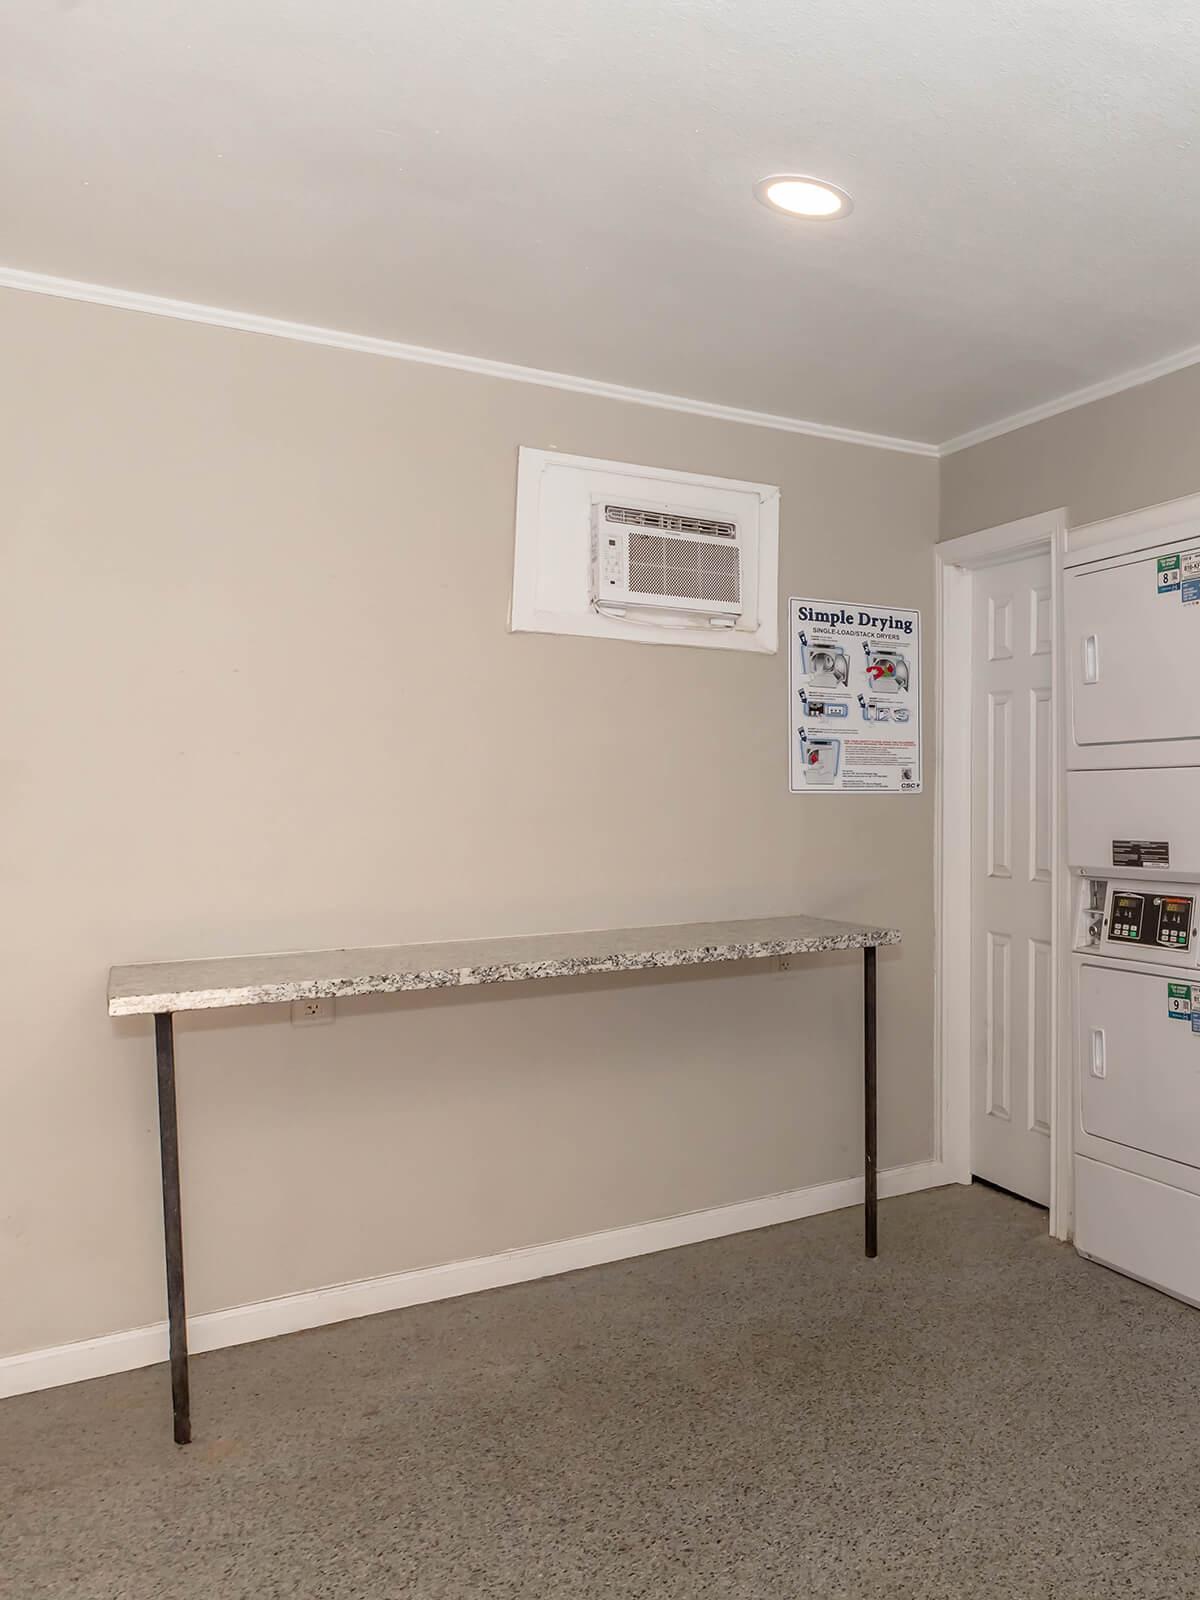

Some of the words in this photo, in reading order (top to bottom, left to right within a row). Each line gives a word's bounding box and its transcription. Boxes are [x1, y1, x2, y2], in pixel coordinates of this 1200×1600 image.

[1163, 573, 1169, 584] 8
[798, 606, 854, 627] Simple
[857, 612, 913, 634] Drying
[812, 627, 875, 639] SINGLE-LOAD/STACK
[876, 632, 901, 640] DRYERS
[1173, 999, 1179, 1010] 9
